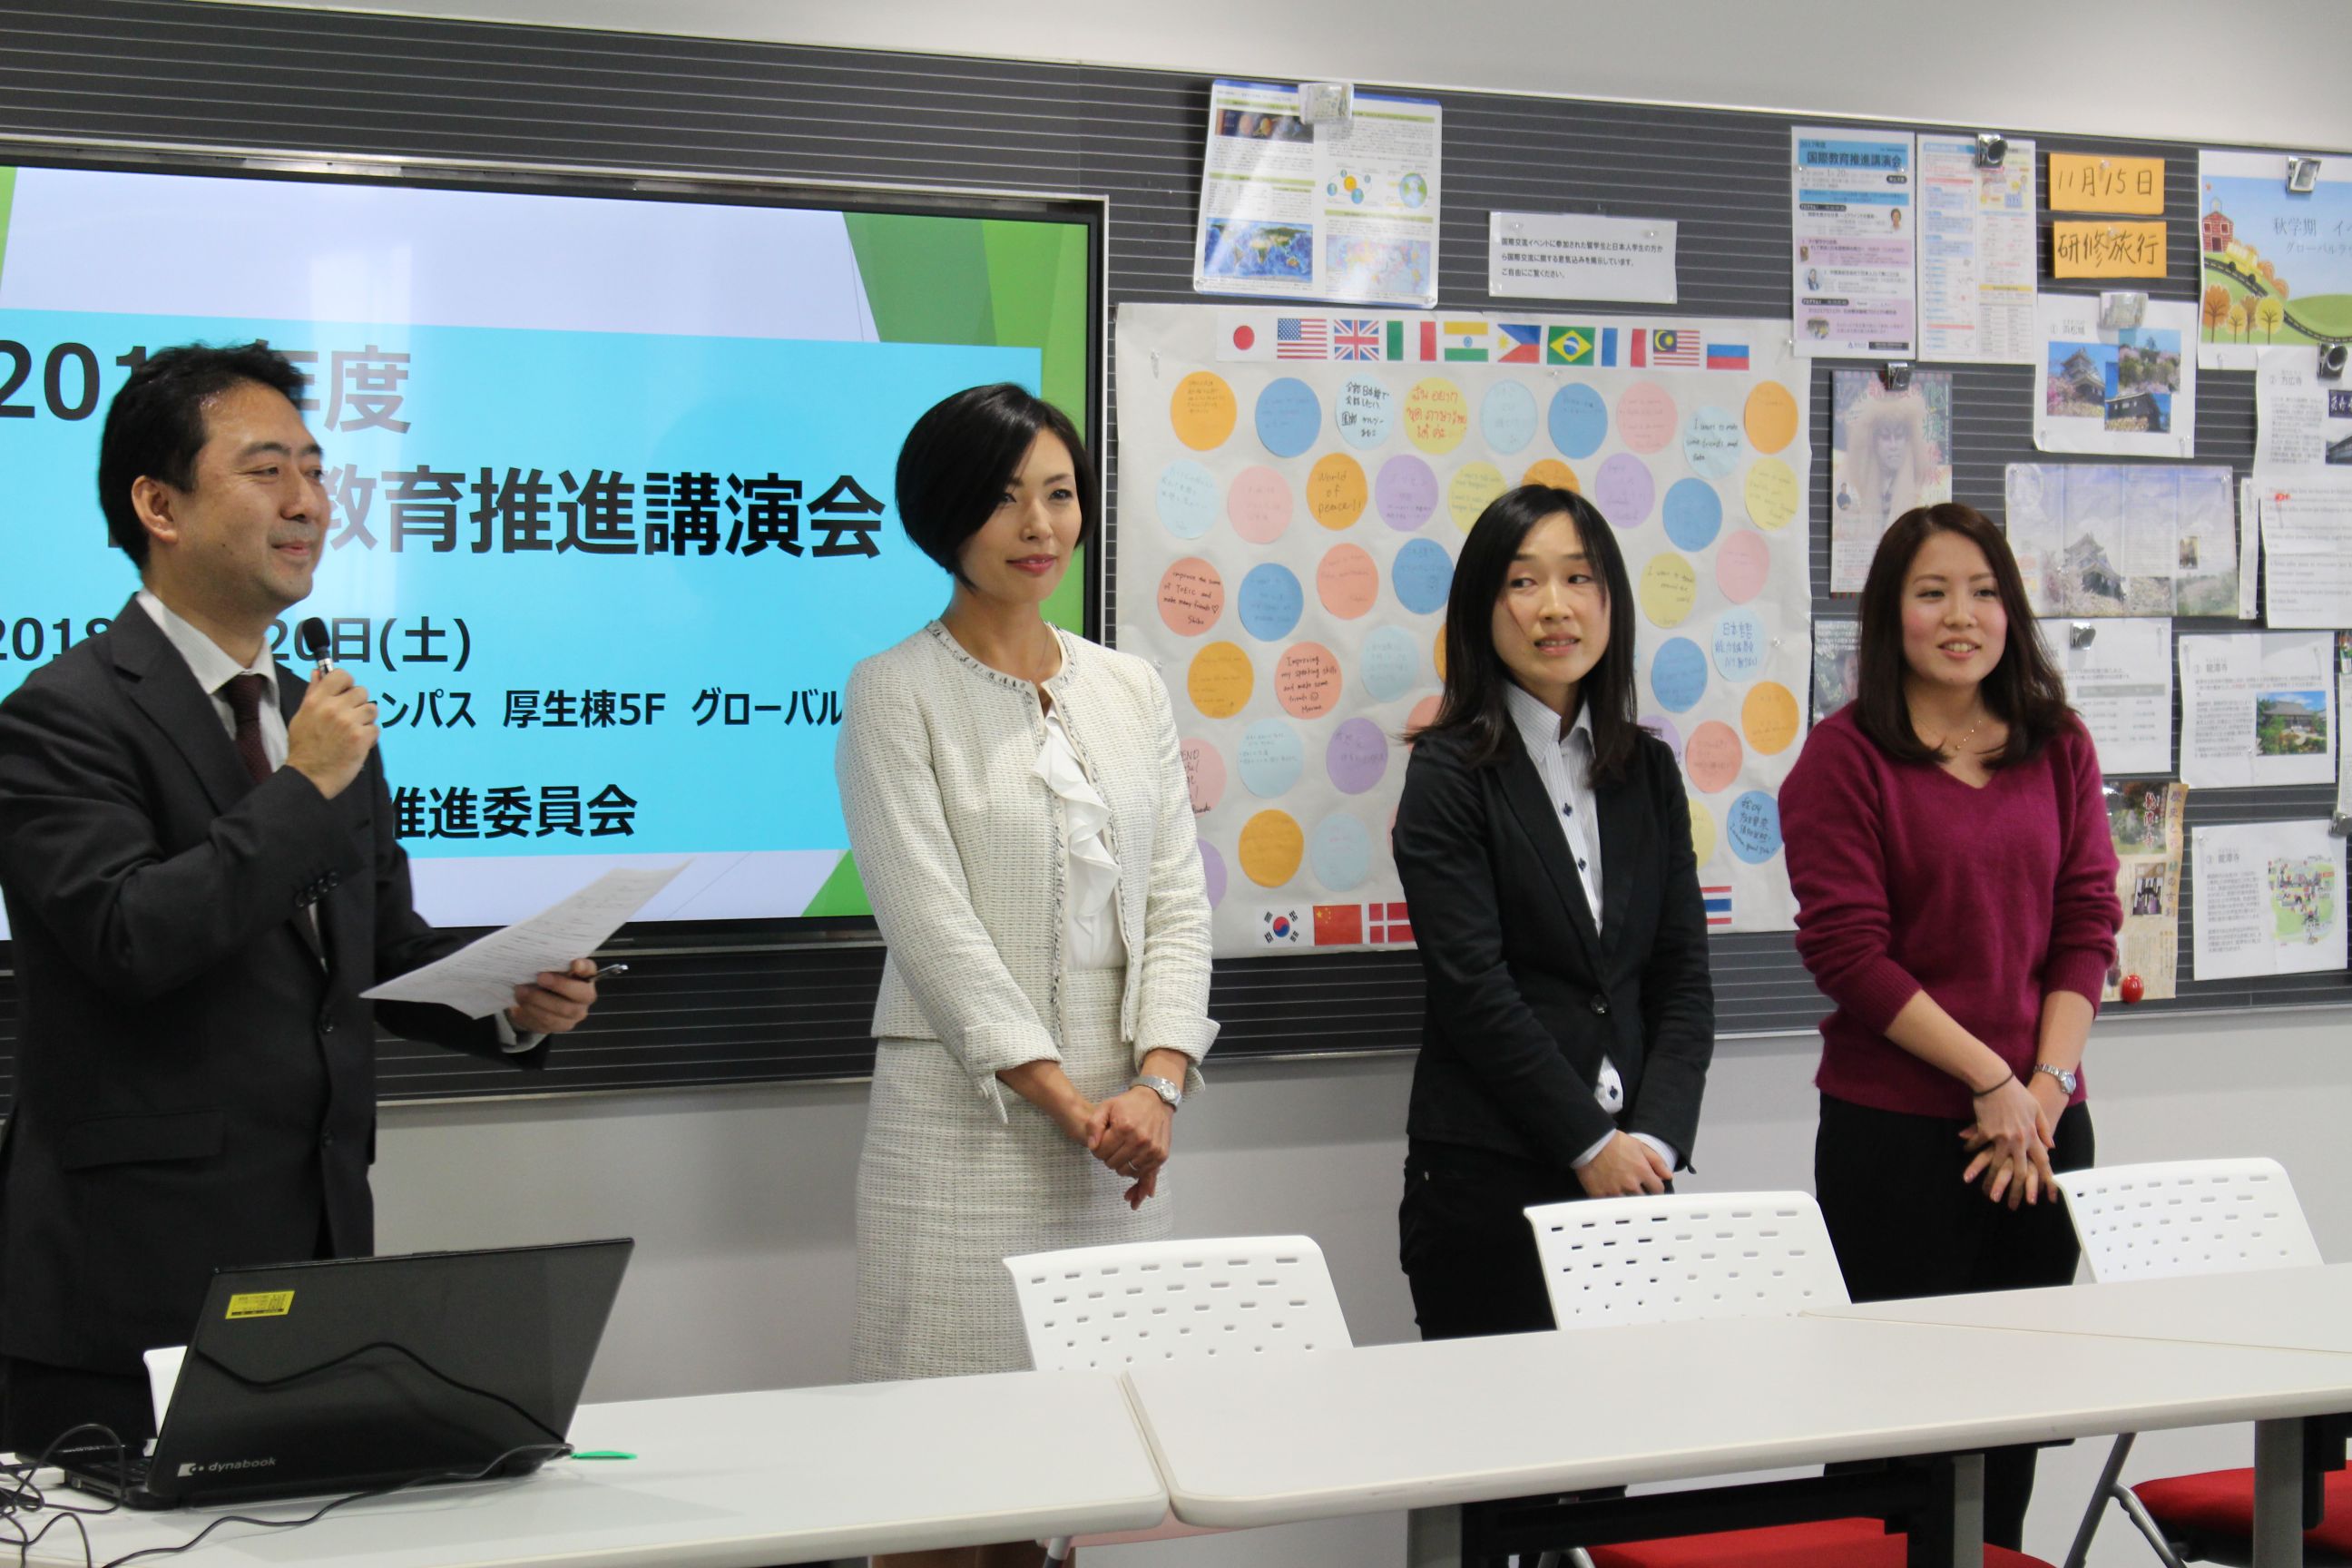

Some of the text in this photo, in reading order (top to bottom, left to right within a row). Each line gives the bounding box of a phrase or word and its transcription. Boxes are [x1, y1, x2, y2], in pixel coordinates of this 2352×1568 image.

[2057, 166, 2152, 197] 11月15日
[2272, 217, 2317, 237] 秋学期
[2057, 229, 2160, 269] 研修旅行
[107, 464, 886, 559] 教育推進講演会
[368, 687, 842, 728] ンパス 厚生棟5F グローバル
[393, 785, 637, 839] 推進委員会
[209, 1457, 276, 1472] dynabook
